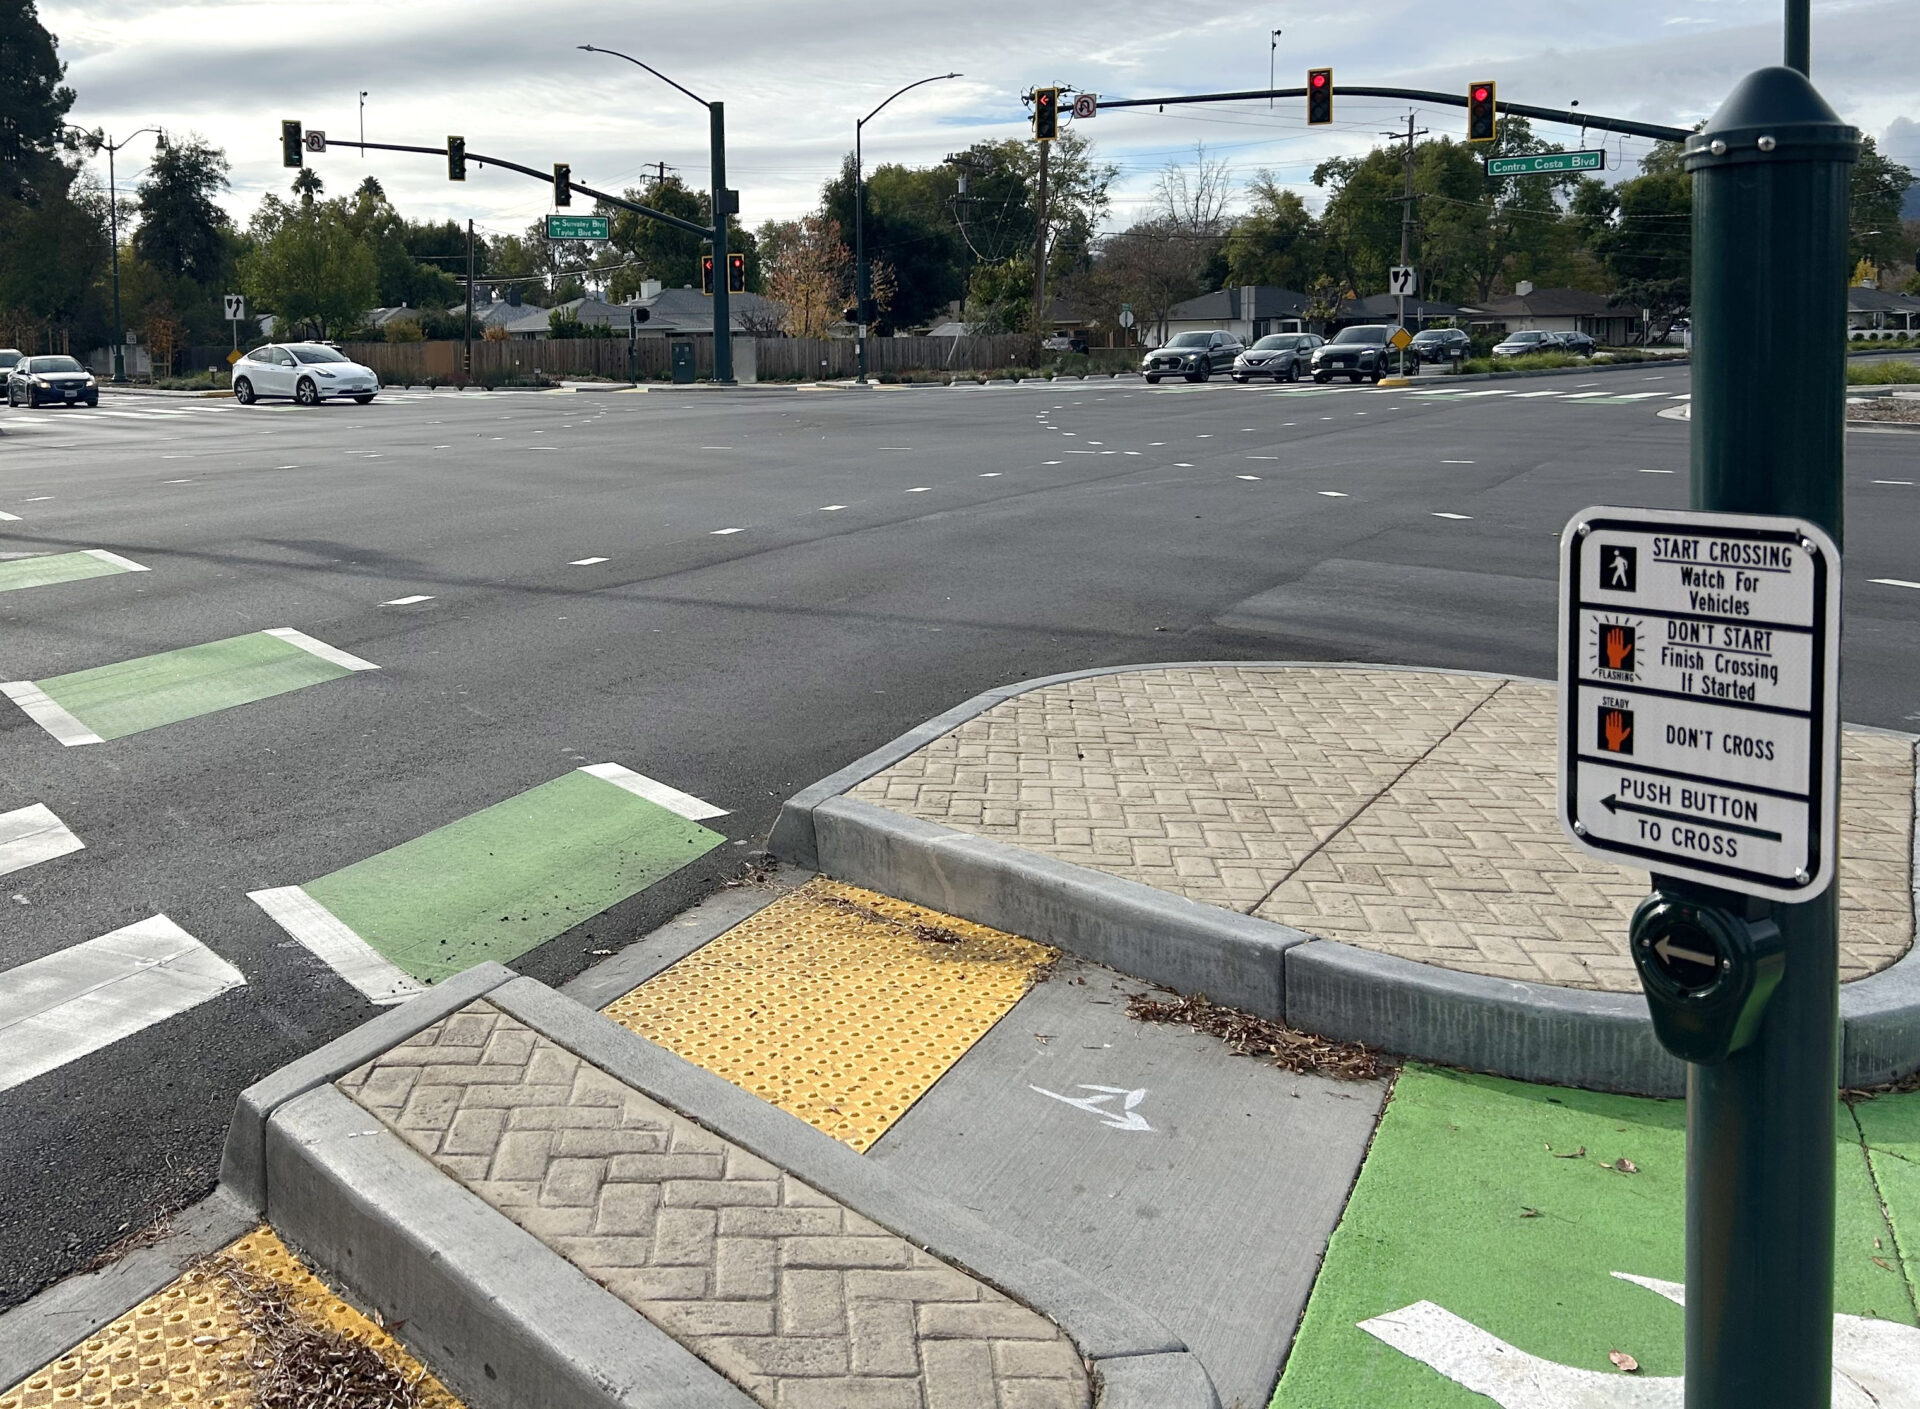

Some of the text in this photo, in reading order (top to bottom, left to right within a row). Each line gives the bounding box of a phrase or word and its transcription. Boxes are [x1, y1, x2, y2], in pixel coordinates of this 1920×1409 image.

[1493, 156, 1595, 172] Contra Costa Blvd
[556, 228, 575, 237] Taylor
[592, 220, 605, 228] Blvd
[1653, 537, 1792, 567] START CROSSING
[1681, 566, 1759, 593] Watch For
[1690, 590, 1750, 616] Vehicles
[1668, 620, 1772, 652] DON'T START
[1599, 668, 1634, 683] FLASHING
[1661, 647, 1778, 687] Finish Crossing
[1682, 672, 1755, 702] If Started
[1602, 696, 1629, 709] STEADY
[1666, 724, 1774, 761] DON'T CROSS
[1621, 777, 1758, 823] PUSH BUTTON
[1638, 819, 1738, 858] TO CROSS
